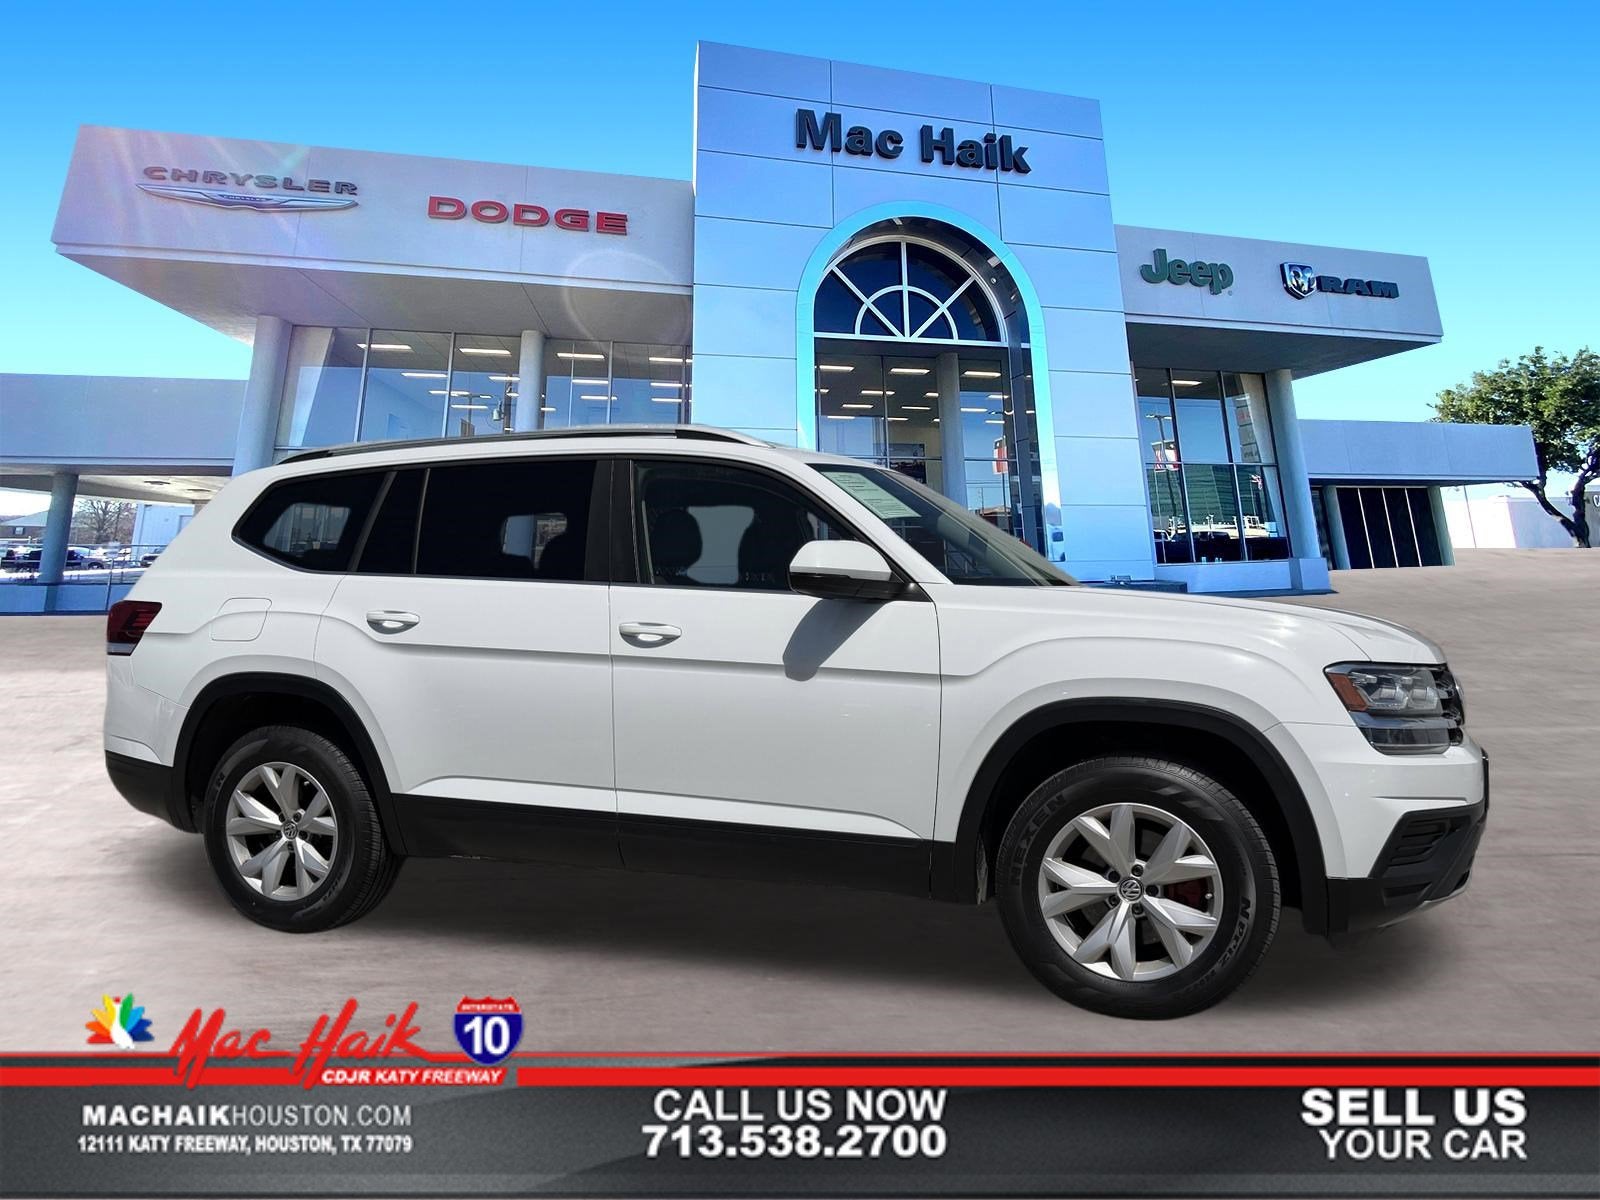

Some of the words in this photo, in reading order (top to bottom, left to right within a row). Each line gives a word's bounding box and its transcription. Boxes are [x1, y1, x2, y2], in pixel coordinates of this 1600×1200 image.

[796, 108, 904, 159] Mac
[920, 124, 1032, 174] Haik
[142, 165, 359, 196] CHRYSLER
[427, 195, 628, 236] DODGE
[1140, 248, 1234, 295] Jeep
[1316, 275, 1399, 299] RAM
